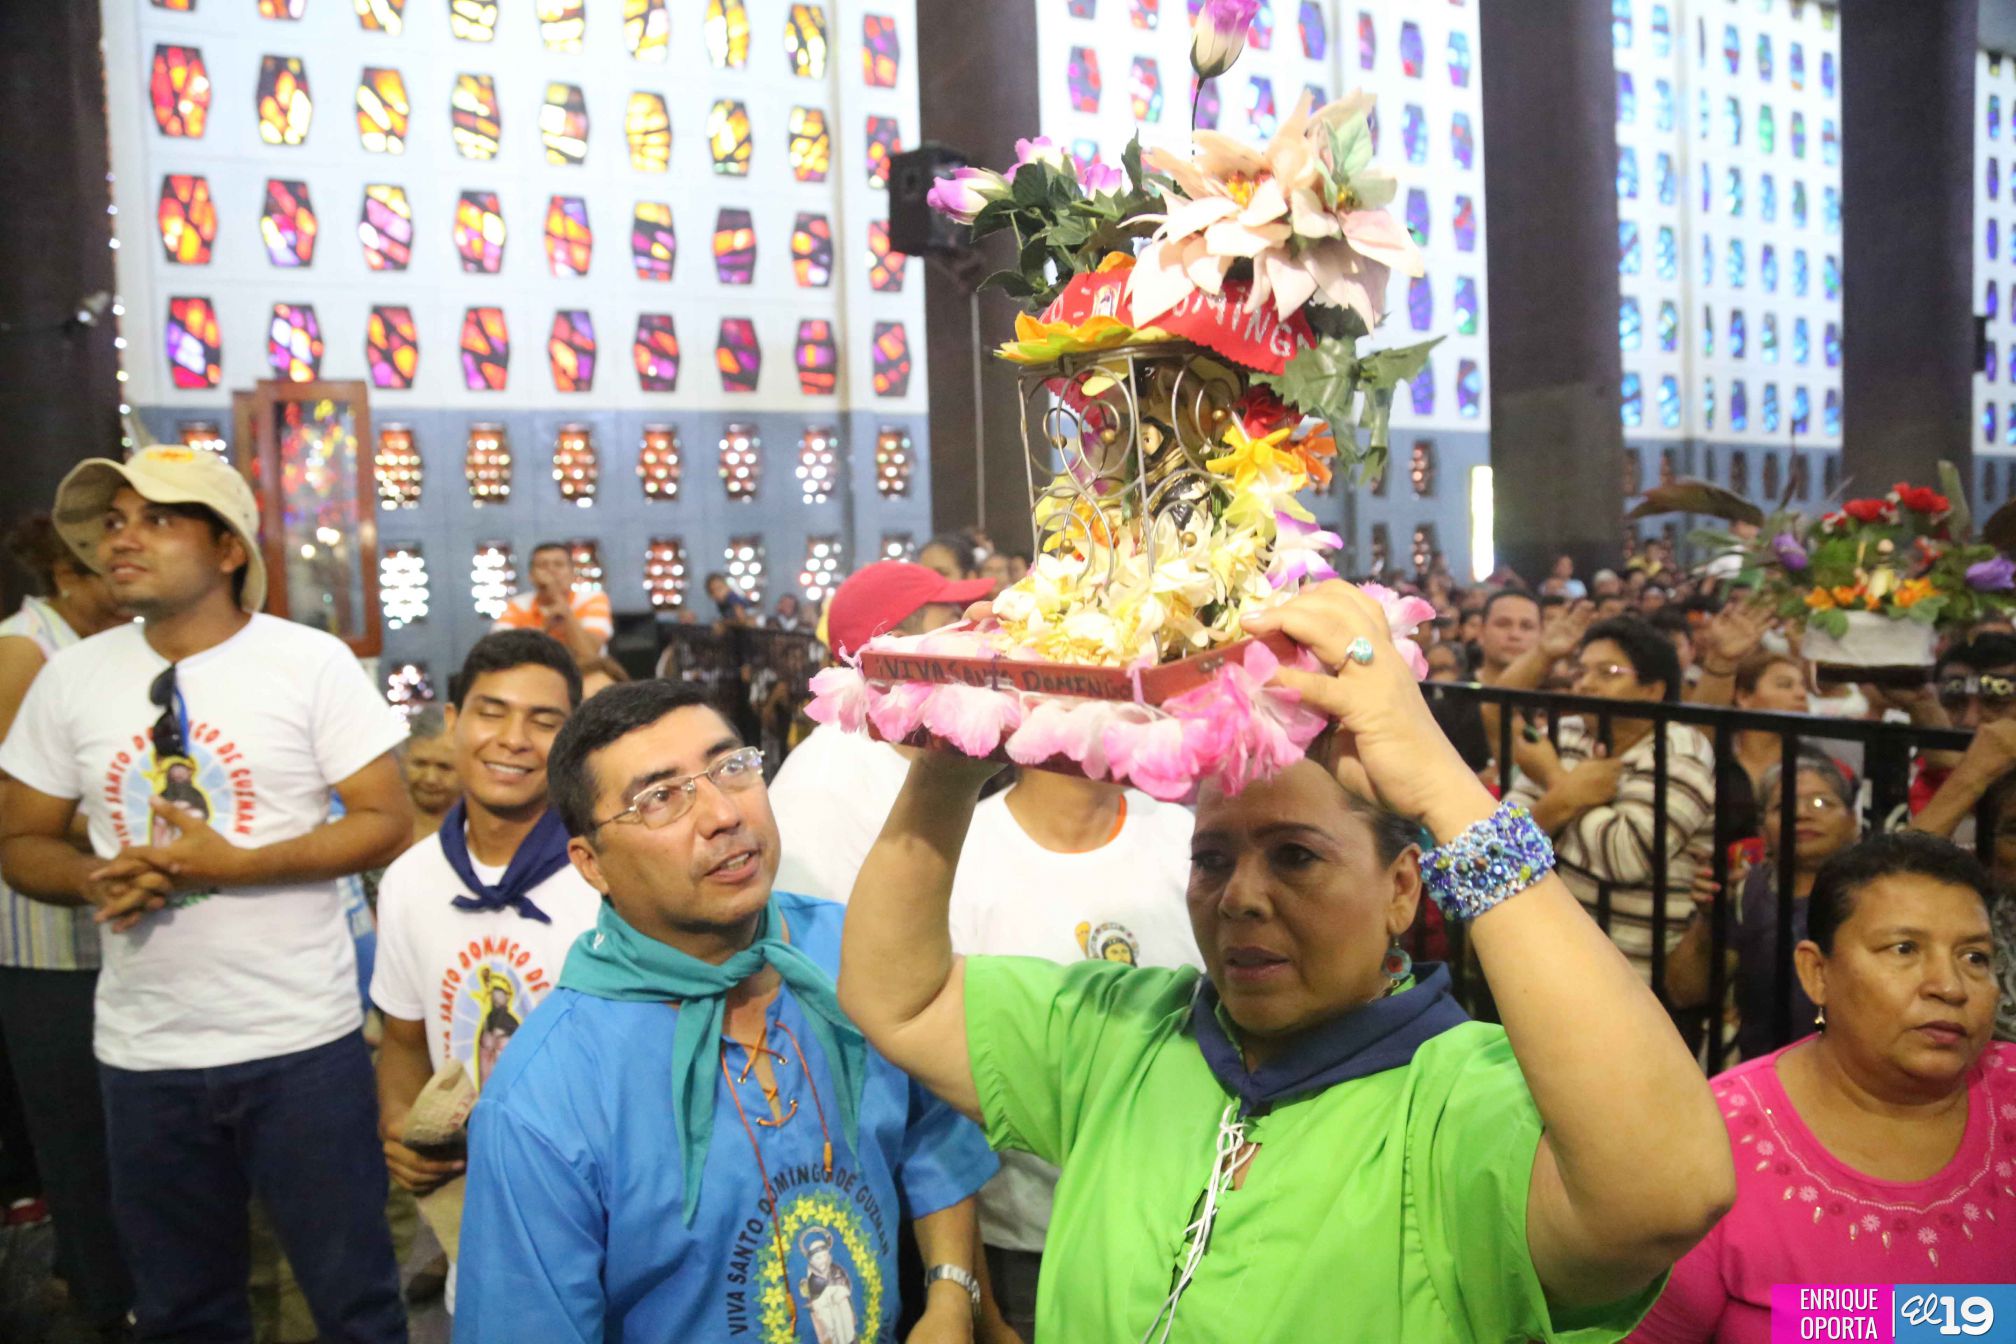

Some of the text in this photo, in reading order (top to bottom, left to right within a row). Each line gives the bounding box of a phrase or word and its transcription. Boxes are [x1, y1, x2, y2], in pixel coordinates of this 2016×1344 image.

[104, 751, 132, 804] SANTO
[216, 742, 243, 765] DE
[524, 967, 551, 993] DE
[835, 1167, 858, 1194] DE
[727, 1217, 764, 1286] SANTO
[727, 1291, 748, 1336] VIVA
